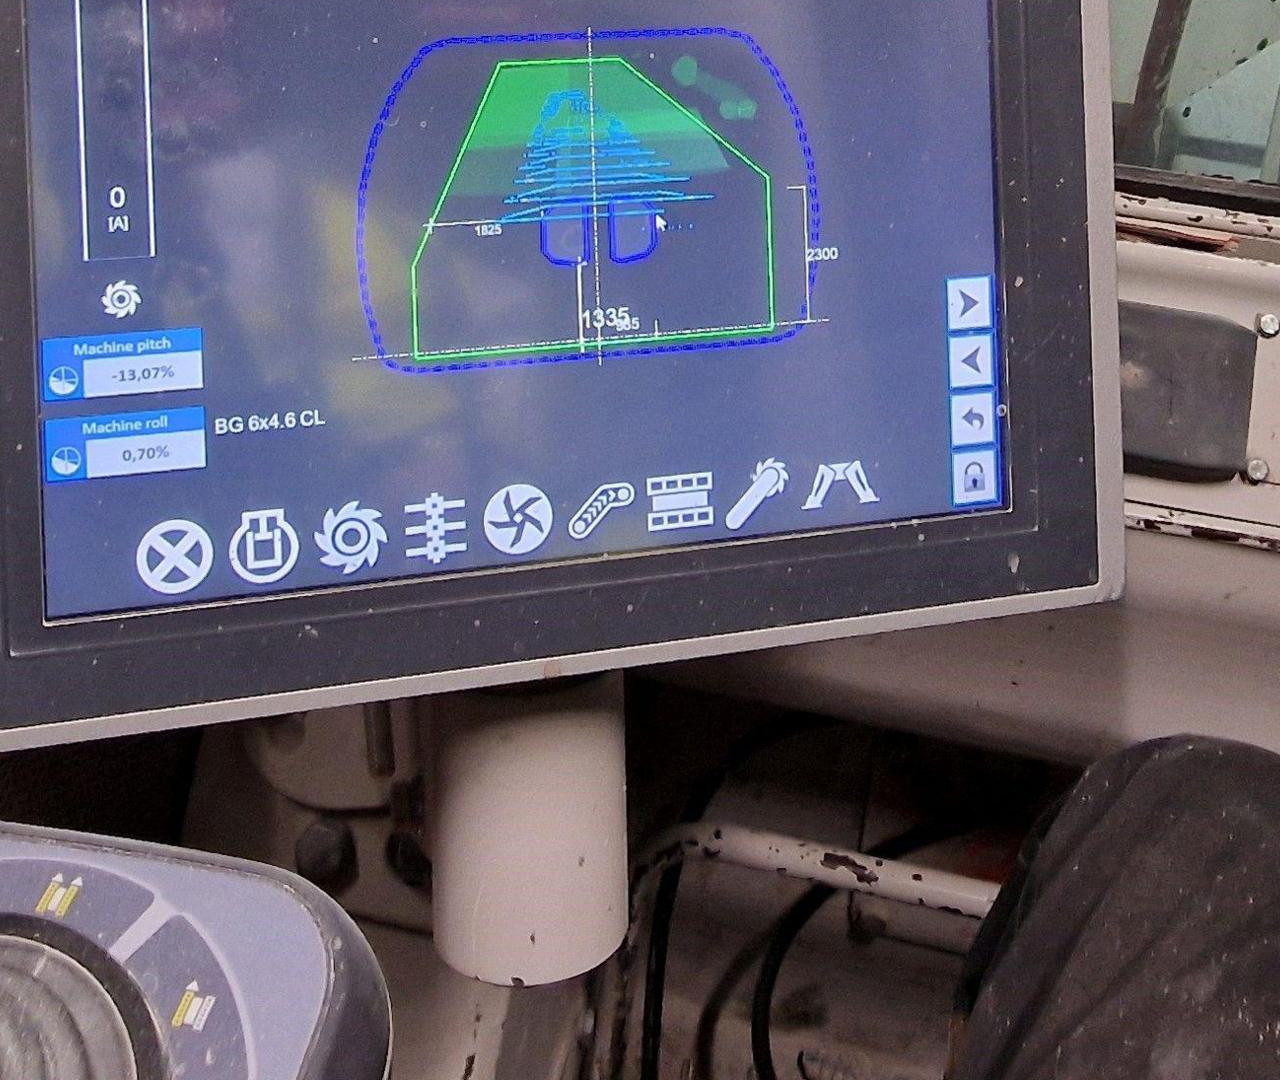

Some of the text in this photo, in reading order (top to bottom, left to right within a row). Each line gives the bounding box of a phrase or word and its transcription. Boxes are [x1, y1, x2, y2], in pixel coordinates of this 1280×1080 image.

[109, 186, 126, 209] 0
[107, 215, 129, 233] [A]
[474, 223, 503, 237] 1825
[807, 247, 839, 262] 2300
[582, 306, 631, 330] 1335
[73, 337, 171, 356] Machine pitch
[111, 365, 175, 383] -13,07%
[82, 415, 168, 436] Machine roll
[214, 409, 326, 435] BG 6x4.6 CL
[122, 445, 170, 463] 0,70%
